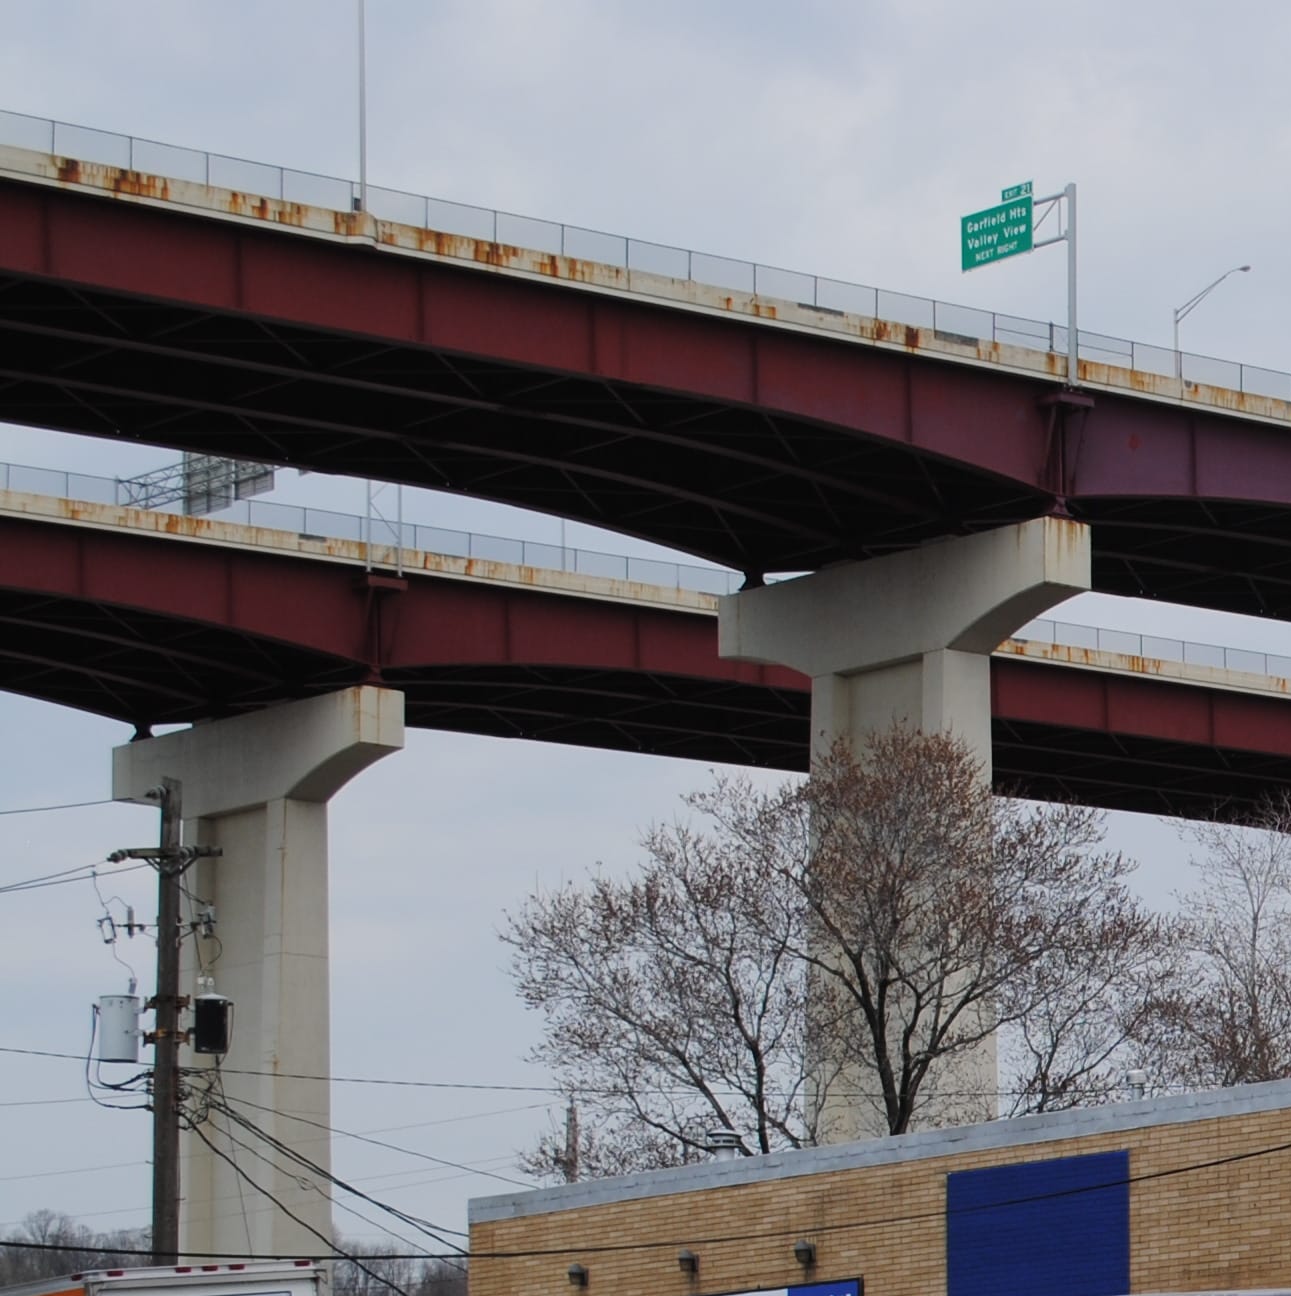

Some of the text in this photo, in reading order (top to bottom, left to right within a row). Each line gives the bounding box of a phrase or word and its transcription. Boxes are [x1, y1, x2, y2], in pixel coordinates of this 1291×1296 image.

[1021, 183, 1030, 195] 21
[967, 206, 1027, 233] Garfield Hts
[967, 223, 1027, 250] Valley View
[975, 248, 994, 262] NEXT
